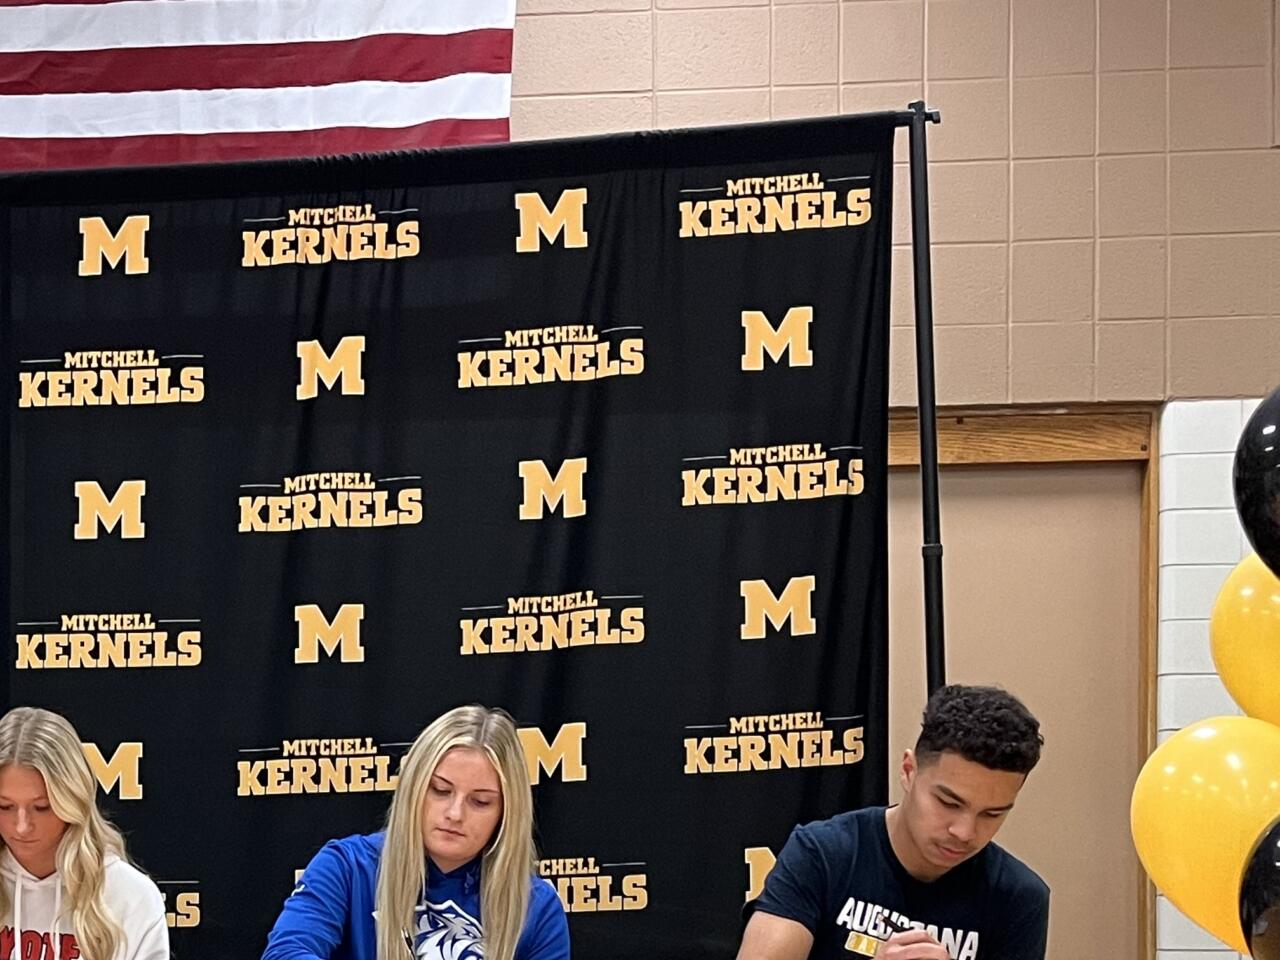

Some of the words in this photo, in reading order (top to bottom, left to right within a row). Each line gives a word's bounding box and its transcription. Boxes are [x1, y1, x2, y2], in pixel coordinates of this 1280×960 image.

[726, 173, 824, 197] MITCHELL
[287, 203, 376, 226] MITCHELL
[514, 187, 589, 253] M
[678, 187, 872, 238] KERNELS
[79, 215, 150, 277] M
[241, 220, 420, 267] KERNELS
[64, 349, 160, 369] MITCHELL
[504, 324, 599, 348] MITCHELL
[741, 305, 814, 371] M
[296, 335, 366, 401] M
[457, 338, 645, 389] KERNELS
[18, 366, 205, 408] KERNELS
[730, 443, 827, 466] MITCHELL
[284, 472, 375, 495] MITCHELL
[518, 457, 588, 520] M
[681, 458, 865, 507] KERNELS
[74, 479, 146, 540] M
[239, 488, 423, 533] KERNELS
[61, 613, 156, 632] MITCHELL
[507, 591, 599, 614] MITCHELL
[739, 575, 817, 640] M
[15, 630, 202, 670] KERNELS
[294, 603, 365, 664] M
[459, 607, 645, 656] KERNELS
[729, 711, 824, 734] MITCHELL
[282, 737, 377, 757] MITCHELL
[516, 722, 587, 786] M
[683, 727, 865, 774] KERNELS
[82, 742, 143, 800] M
[237, 755, 402, 796] KERNEL
[538, 857, 600, 876] CHELL
[545, 873, 648, 913] NELS
